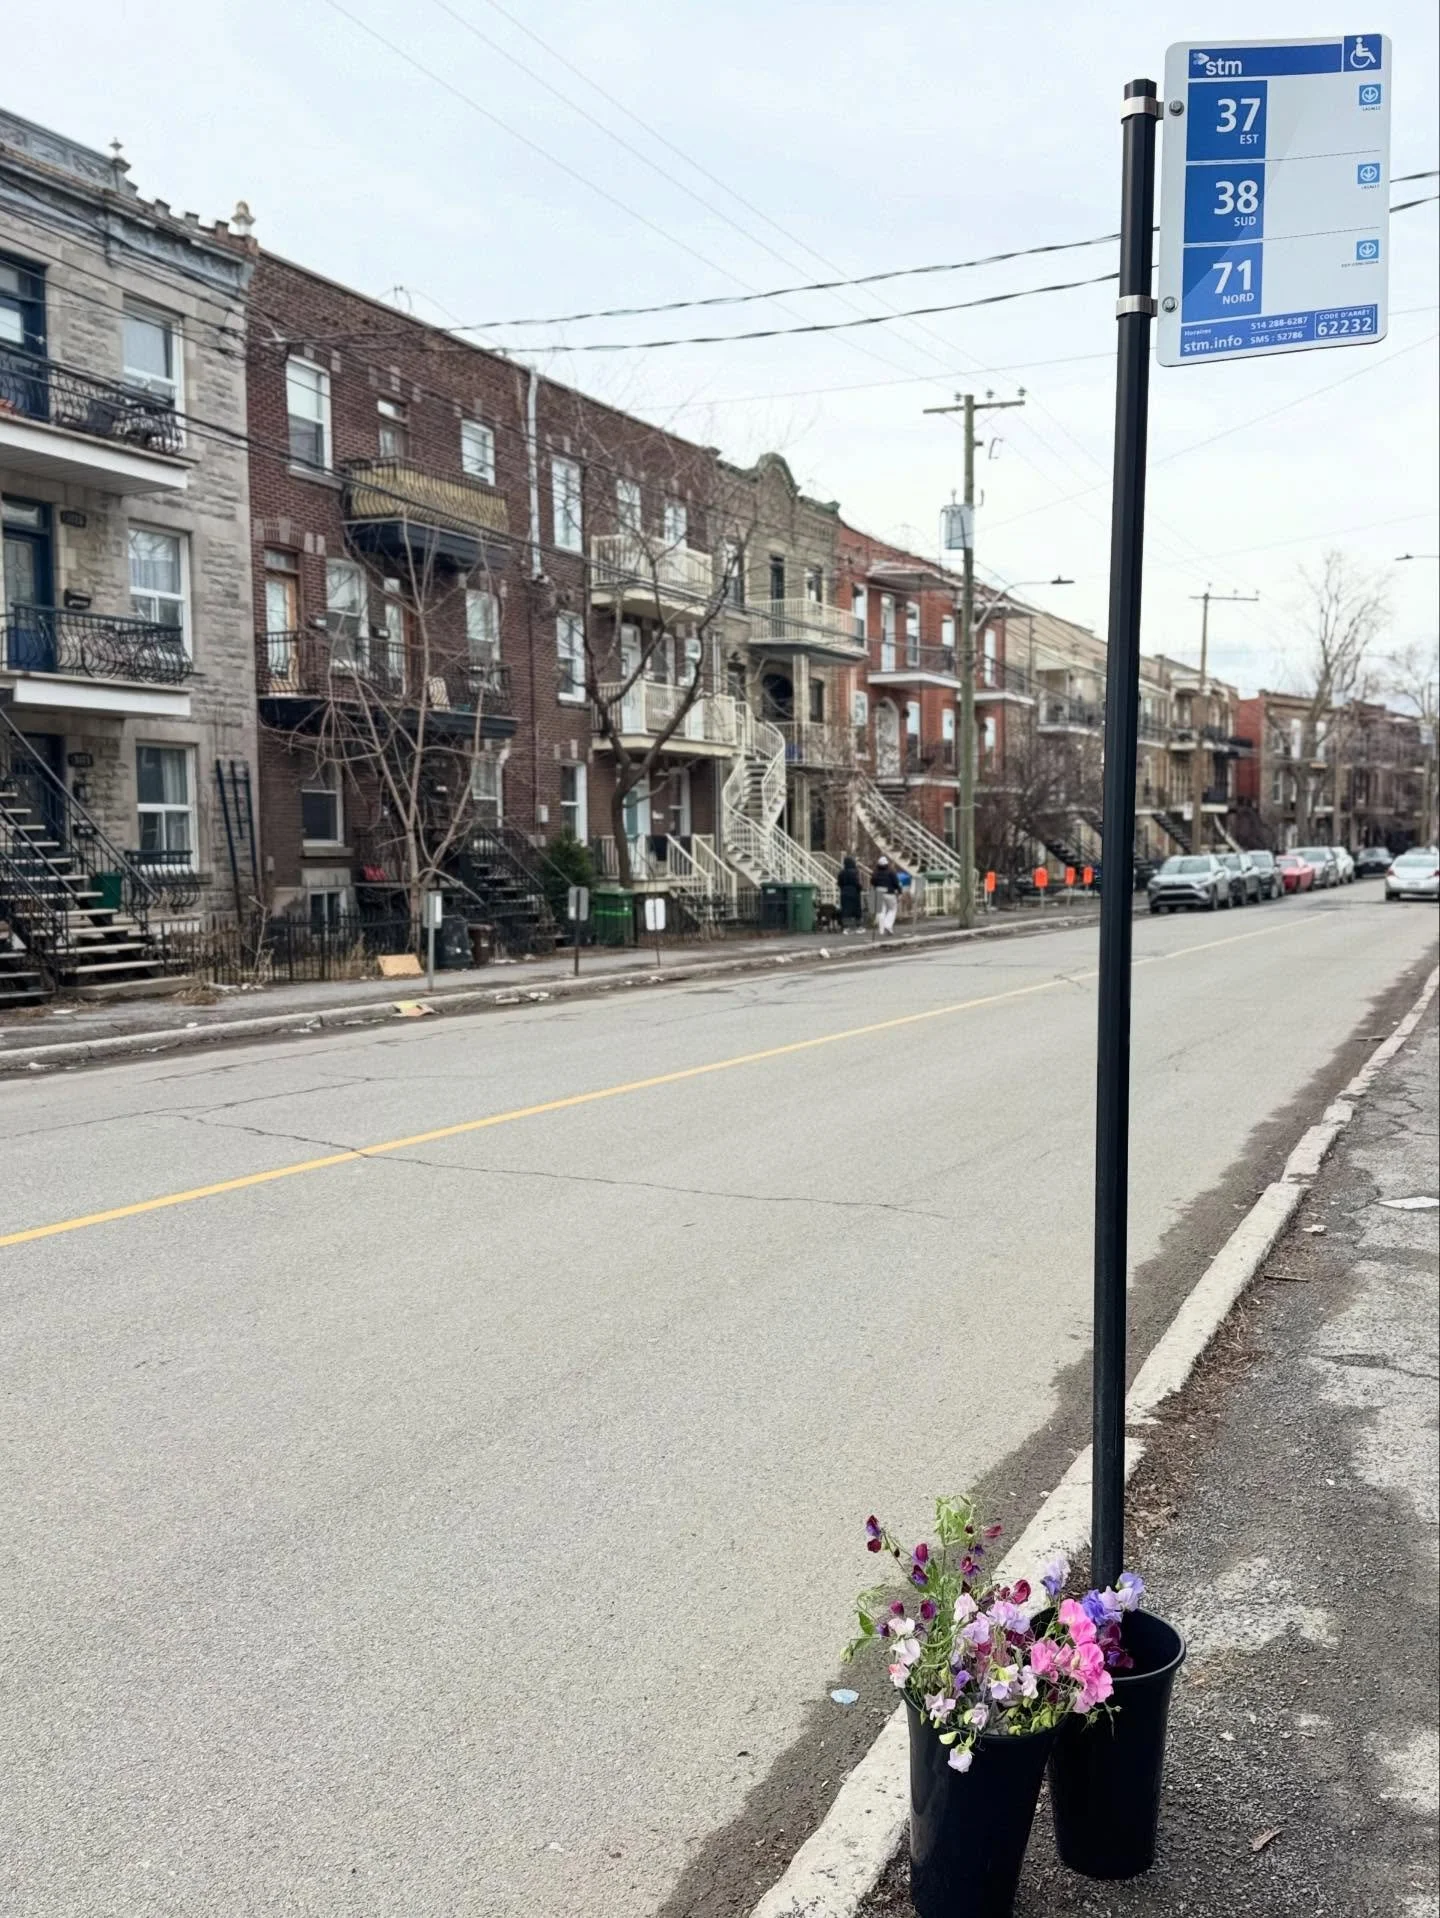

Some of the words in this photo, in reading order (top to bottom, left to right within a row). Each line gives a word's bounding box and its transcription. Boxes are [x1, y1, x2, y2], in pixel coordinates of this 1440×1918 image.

[1205, 58, 1242, 75] stm
[1216, 98, 1261, 133] 37
[1239, 134, 1258, 144] EST
[1213, 180, 1258, 215] 38
[1234, 216, 1256, 227] SUD
[1212, 259, 1252, 294] 71
[1222, 292, 1254, 305] NORD
[1251, 321, 1267, 330] 514
[1268, 316, 1308, 328] 288-6287
[1317, 317, 1372, 336] 62232
[1183, 335, 1243, 353] stm.info
[1250, 334, 1270, 344] SMS
[1277, 331, 1303, 342] 52786
